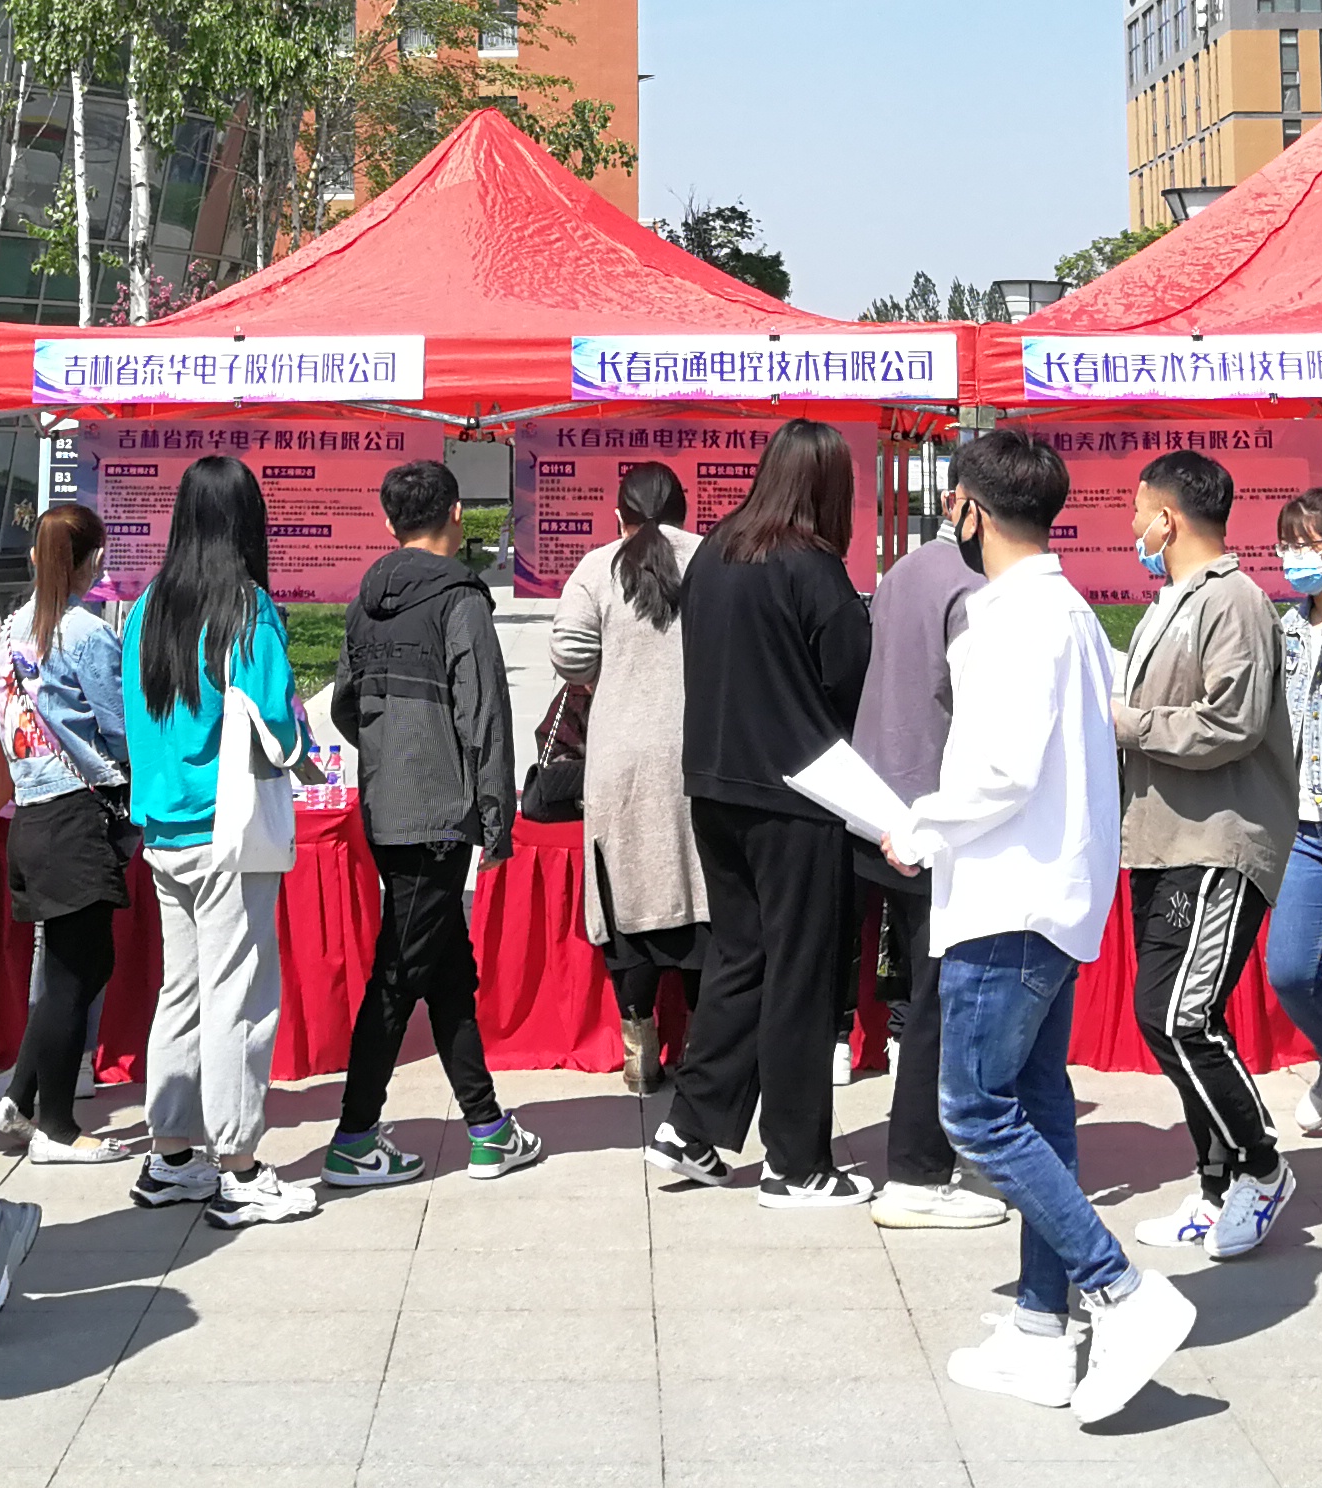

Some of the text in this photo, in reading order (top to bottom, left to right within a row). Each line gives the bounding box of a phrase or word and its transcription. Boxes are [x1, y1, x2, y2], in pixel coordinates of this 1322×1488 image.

[63, 352, 397, 387] 吉林省泰华电子股份有限公司
[596, 350, 933, 383] 长春京通电控技术有限公司
[118, 429, 405, 451] 吉林省泰华电子股份有限公司
[556, 428, 771, 449] 长春京通电控技术有
[1038, 429, 1274, 451] 柏美水务科技有限公司
[54, 472, 72, 483] B3
